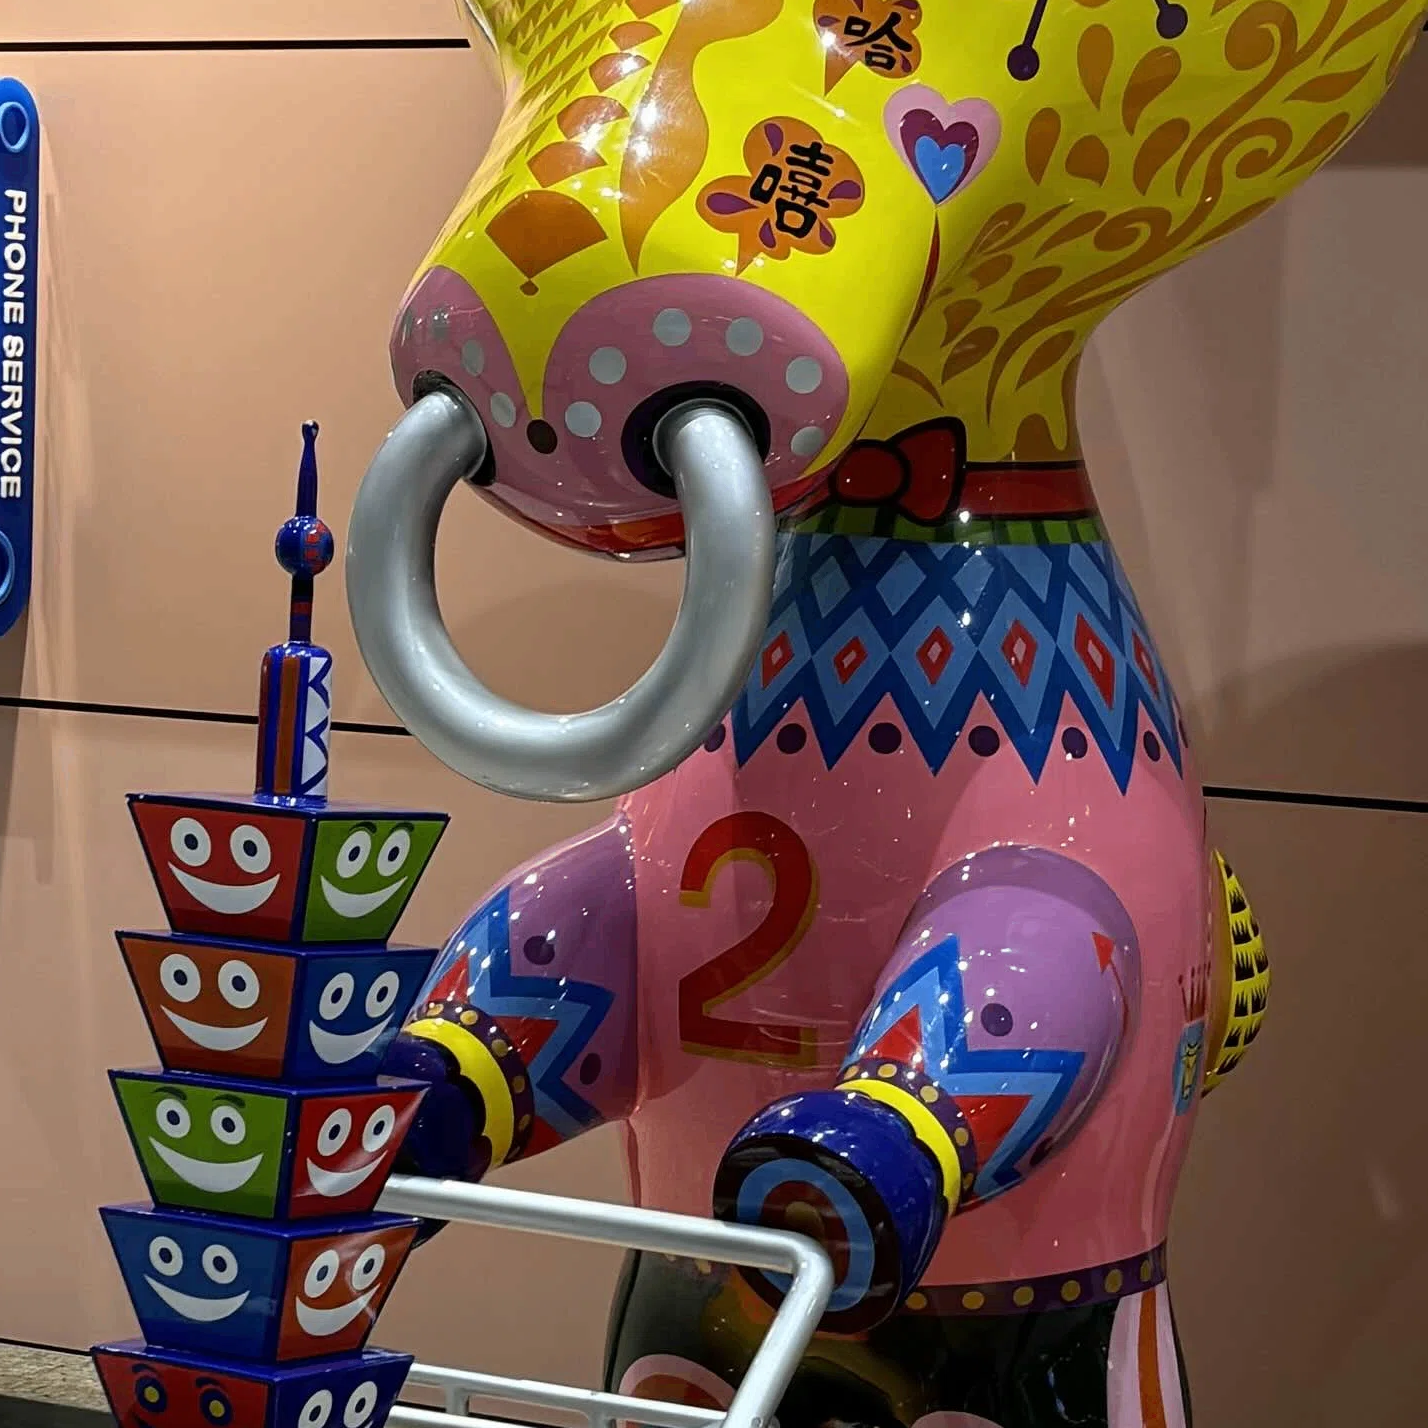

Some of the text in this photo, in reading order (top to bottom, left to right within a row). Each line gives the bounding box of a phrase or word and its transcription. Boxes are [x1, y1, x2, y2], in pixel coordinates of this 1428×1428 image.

[843, 11, 913, 71] 哈
[749, 141, 835, 239] 嘻
[0, 188, 27, 499] PHONE SERVICE
[677, 810, 820, 1069] 2
